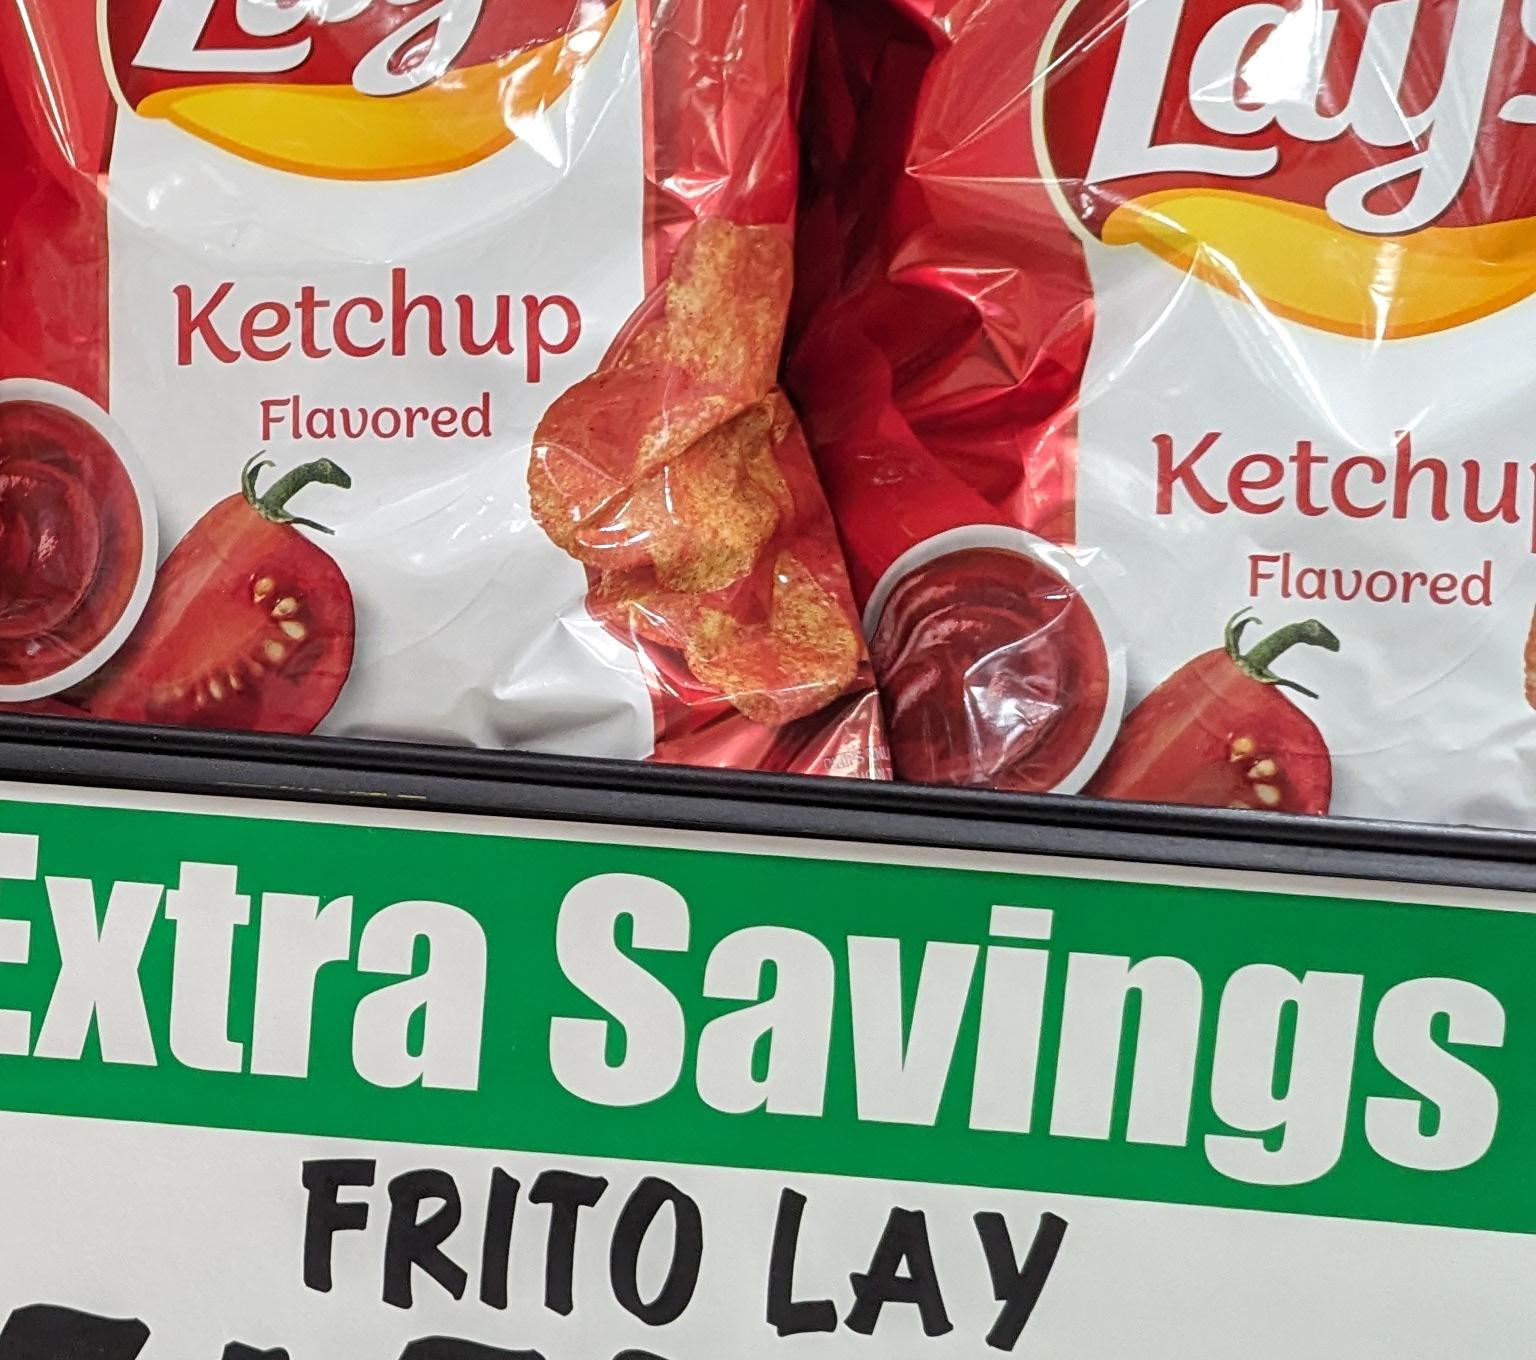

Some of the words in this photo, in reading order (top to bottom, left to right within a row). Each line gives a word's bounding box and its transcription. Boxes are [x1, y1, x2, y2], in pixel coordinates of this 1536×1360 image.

[172, 266, 582, 384] Ketchup
[259, 391, 493, 441] Flavored
[1151, 429, 1536, 555] Ketchu
[1248, 552, 1493, 607] Flavored
[548, 871, 1507, 1187] Savings
[301, 1157, 703, 1327] FRITO
[766, 1186, 1068, 1352] LAY
